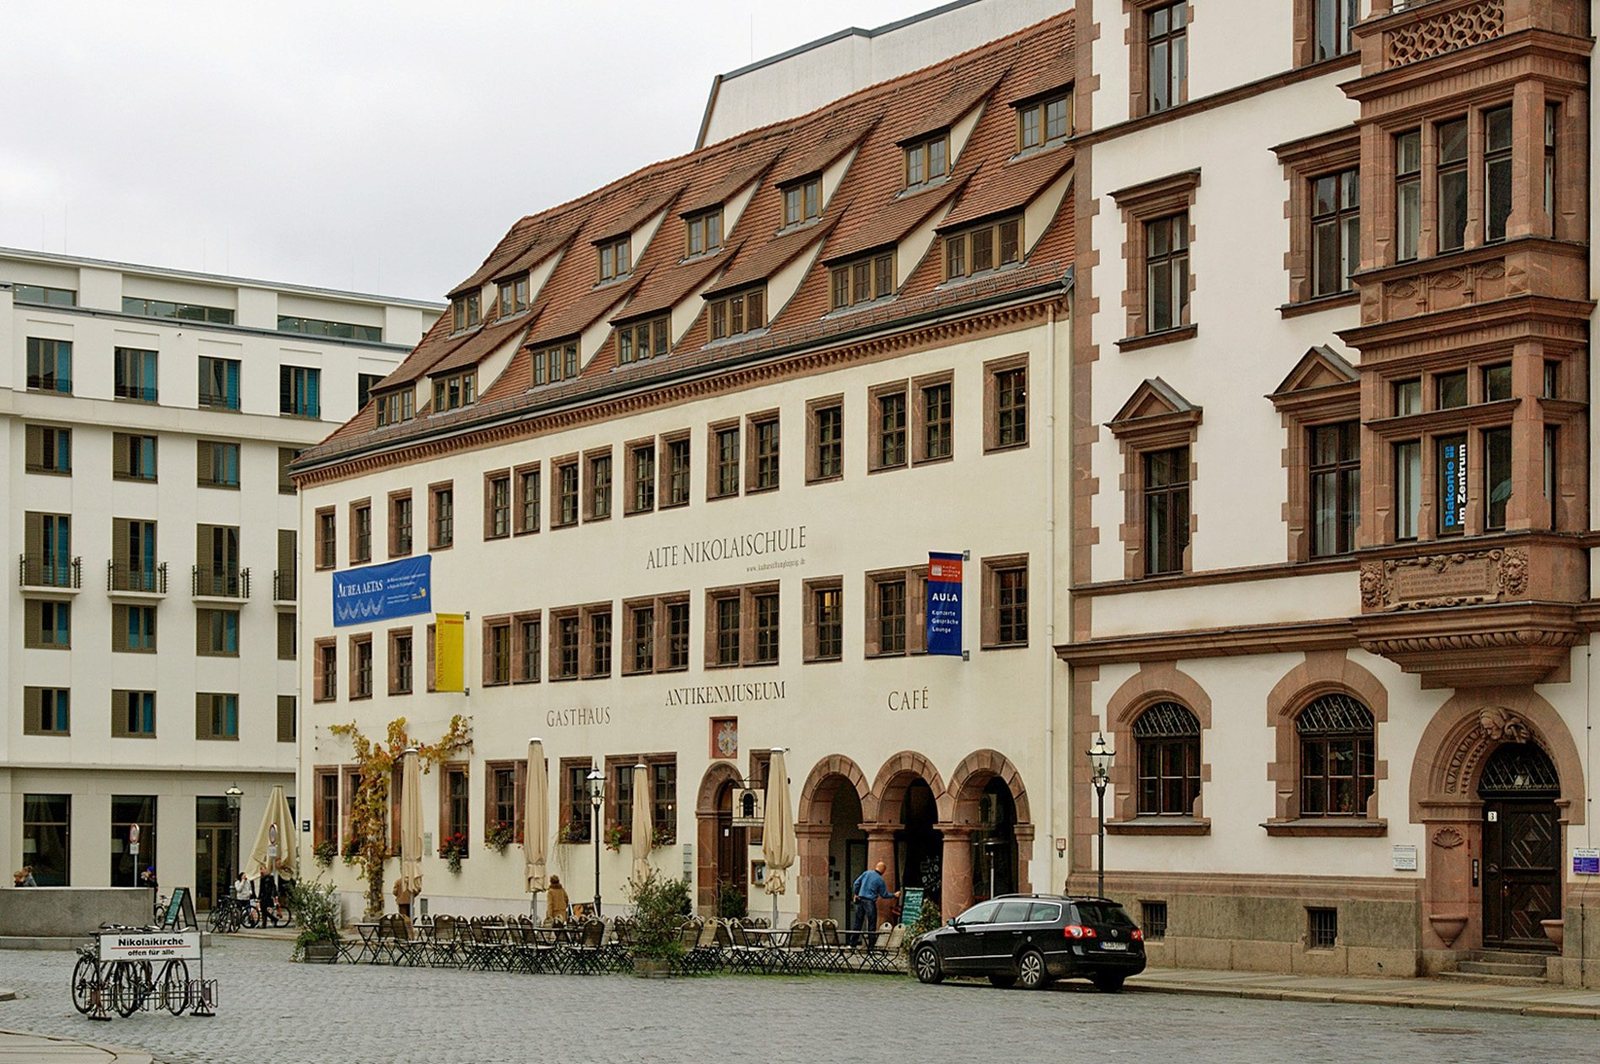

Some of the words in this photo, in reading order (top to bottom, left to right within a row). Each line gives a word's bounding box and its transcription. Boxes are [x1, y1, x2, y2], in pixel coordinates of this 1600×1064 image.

[1457, 443, 1466, 504] Zentrum
[1445, 461, 1455, 526] Diakonie
[646, 545, 678, 570] ALTE
[683, 525, 807, 565] NIKOLAISCHULE
[337, 582, 361, 598] AUREA
[362, 579, 383, 595] AETAS
[931, 592, 958, 602] AULA
[931, 626, 951, 634] Lounge
[665, 680, 786, 706] ANTIKENMUSEUM
[887, 686, 929, 712] CAFÉ
[546, 706, 612, 728] GASTHAUS
[118, 937, 184, 947] Nikolaikirche
[127, 949, 147, 957] offen
